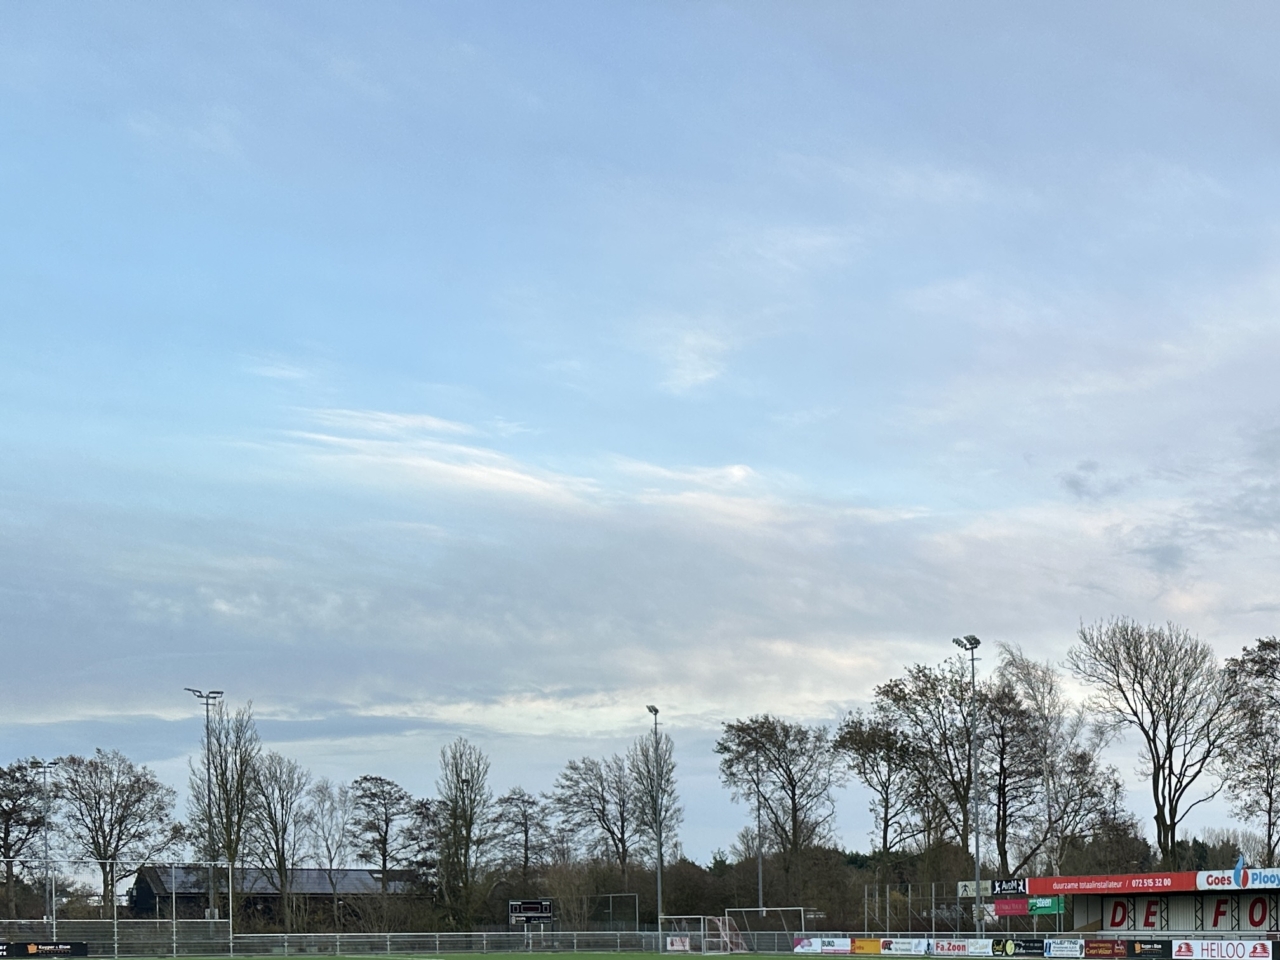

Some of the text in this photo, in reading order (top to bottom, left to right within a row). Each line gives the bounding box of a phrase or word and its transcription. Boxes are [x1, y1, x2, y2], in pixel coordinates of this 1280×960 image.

[1053, 881, 1079, 890] duurzame
[1132, 879, 1142, 888] 072
[1154, 878, 1163, 887] 32
[1163, 877, 1172, 887] 00
[1206, 874, 1232, 886] Goes
[1201, 942, 1246, 959] HEILOO
